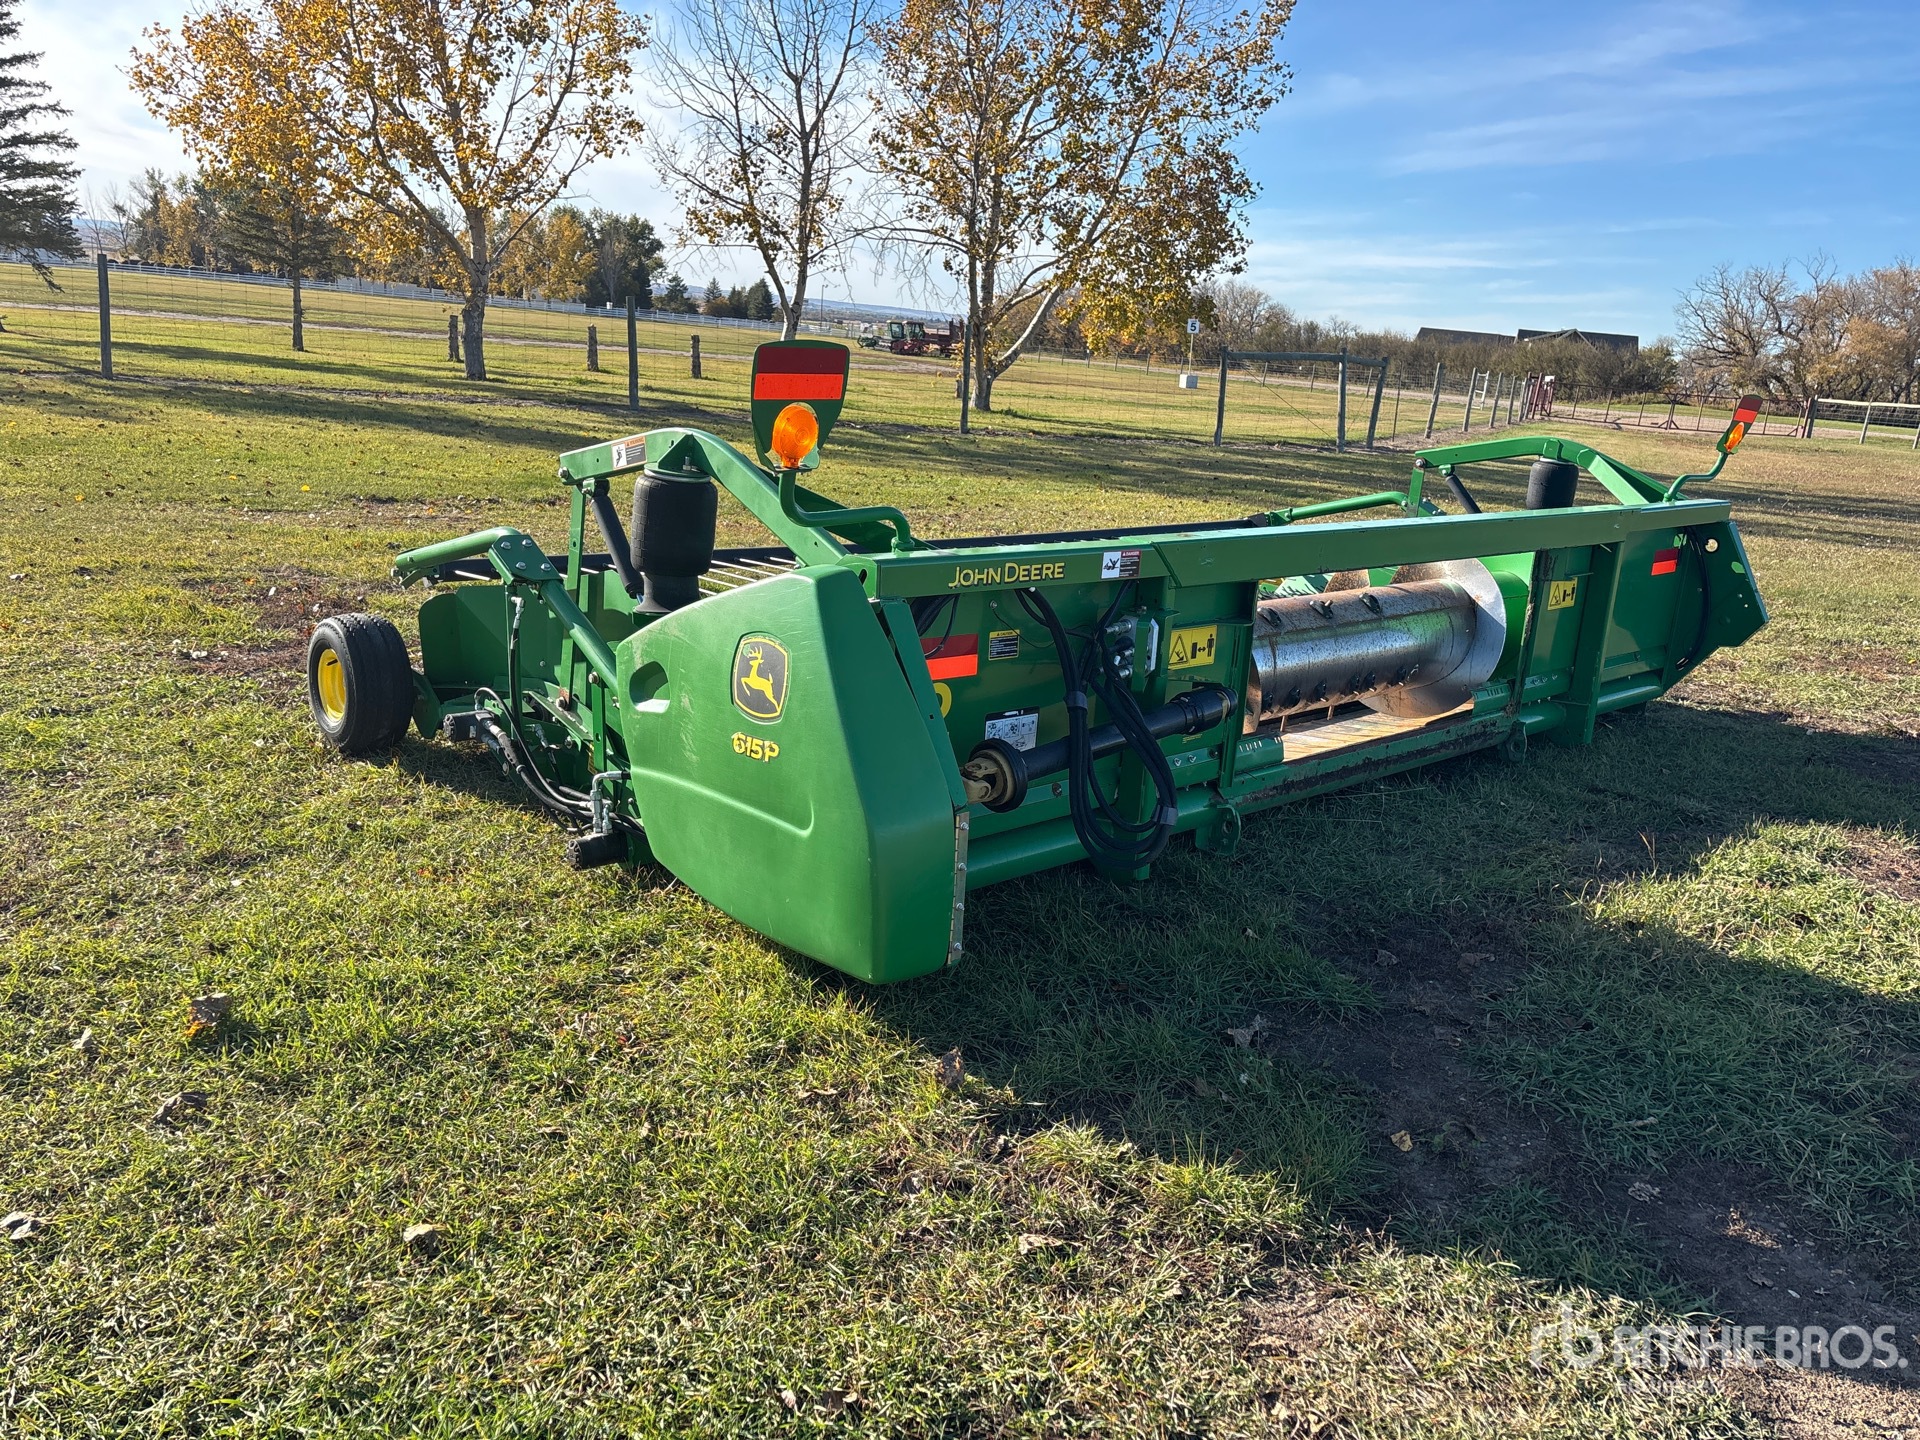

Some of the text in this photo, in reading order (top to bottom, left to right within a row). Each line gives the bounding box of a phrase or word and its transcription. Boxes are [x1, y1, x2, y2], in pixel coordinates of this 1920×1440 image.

[1190, 322, 1197, 331] 5
[948, 562, 1065, 588] JOHN DEERE
[731, 732, 780, 762] 615P
